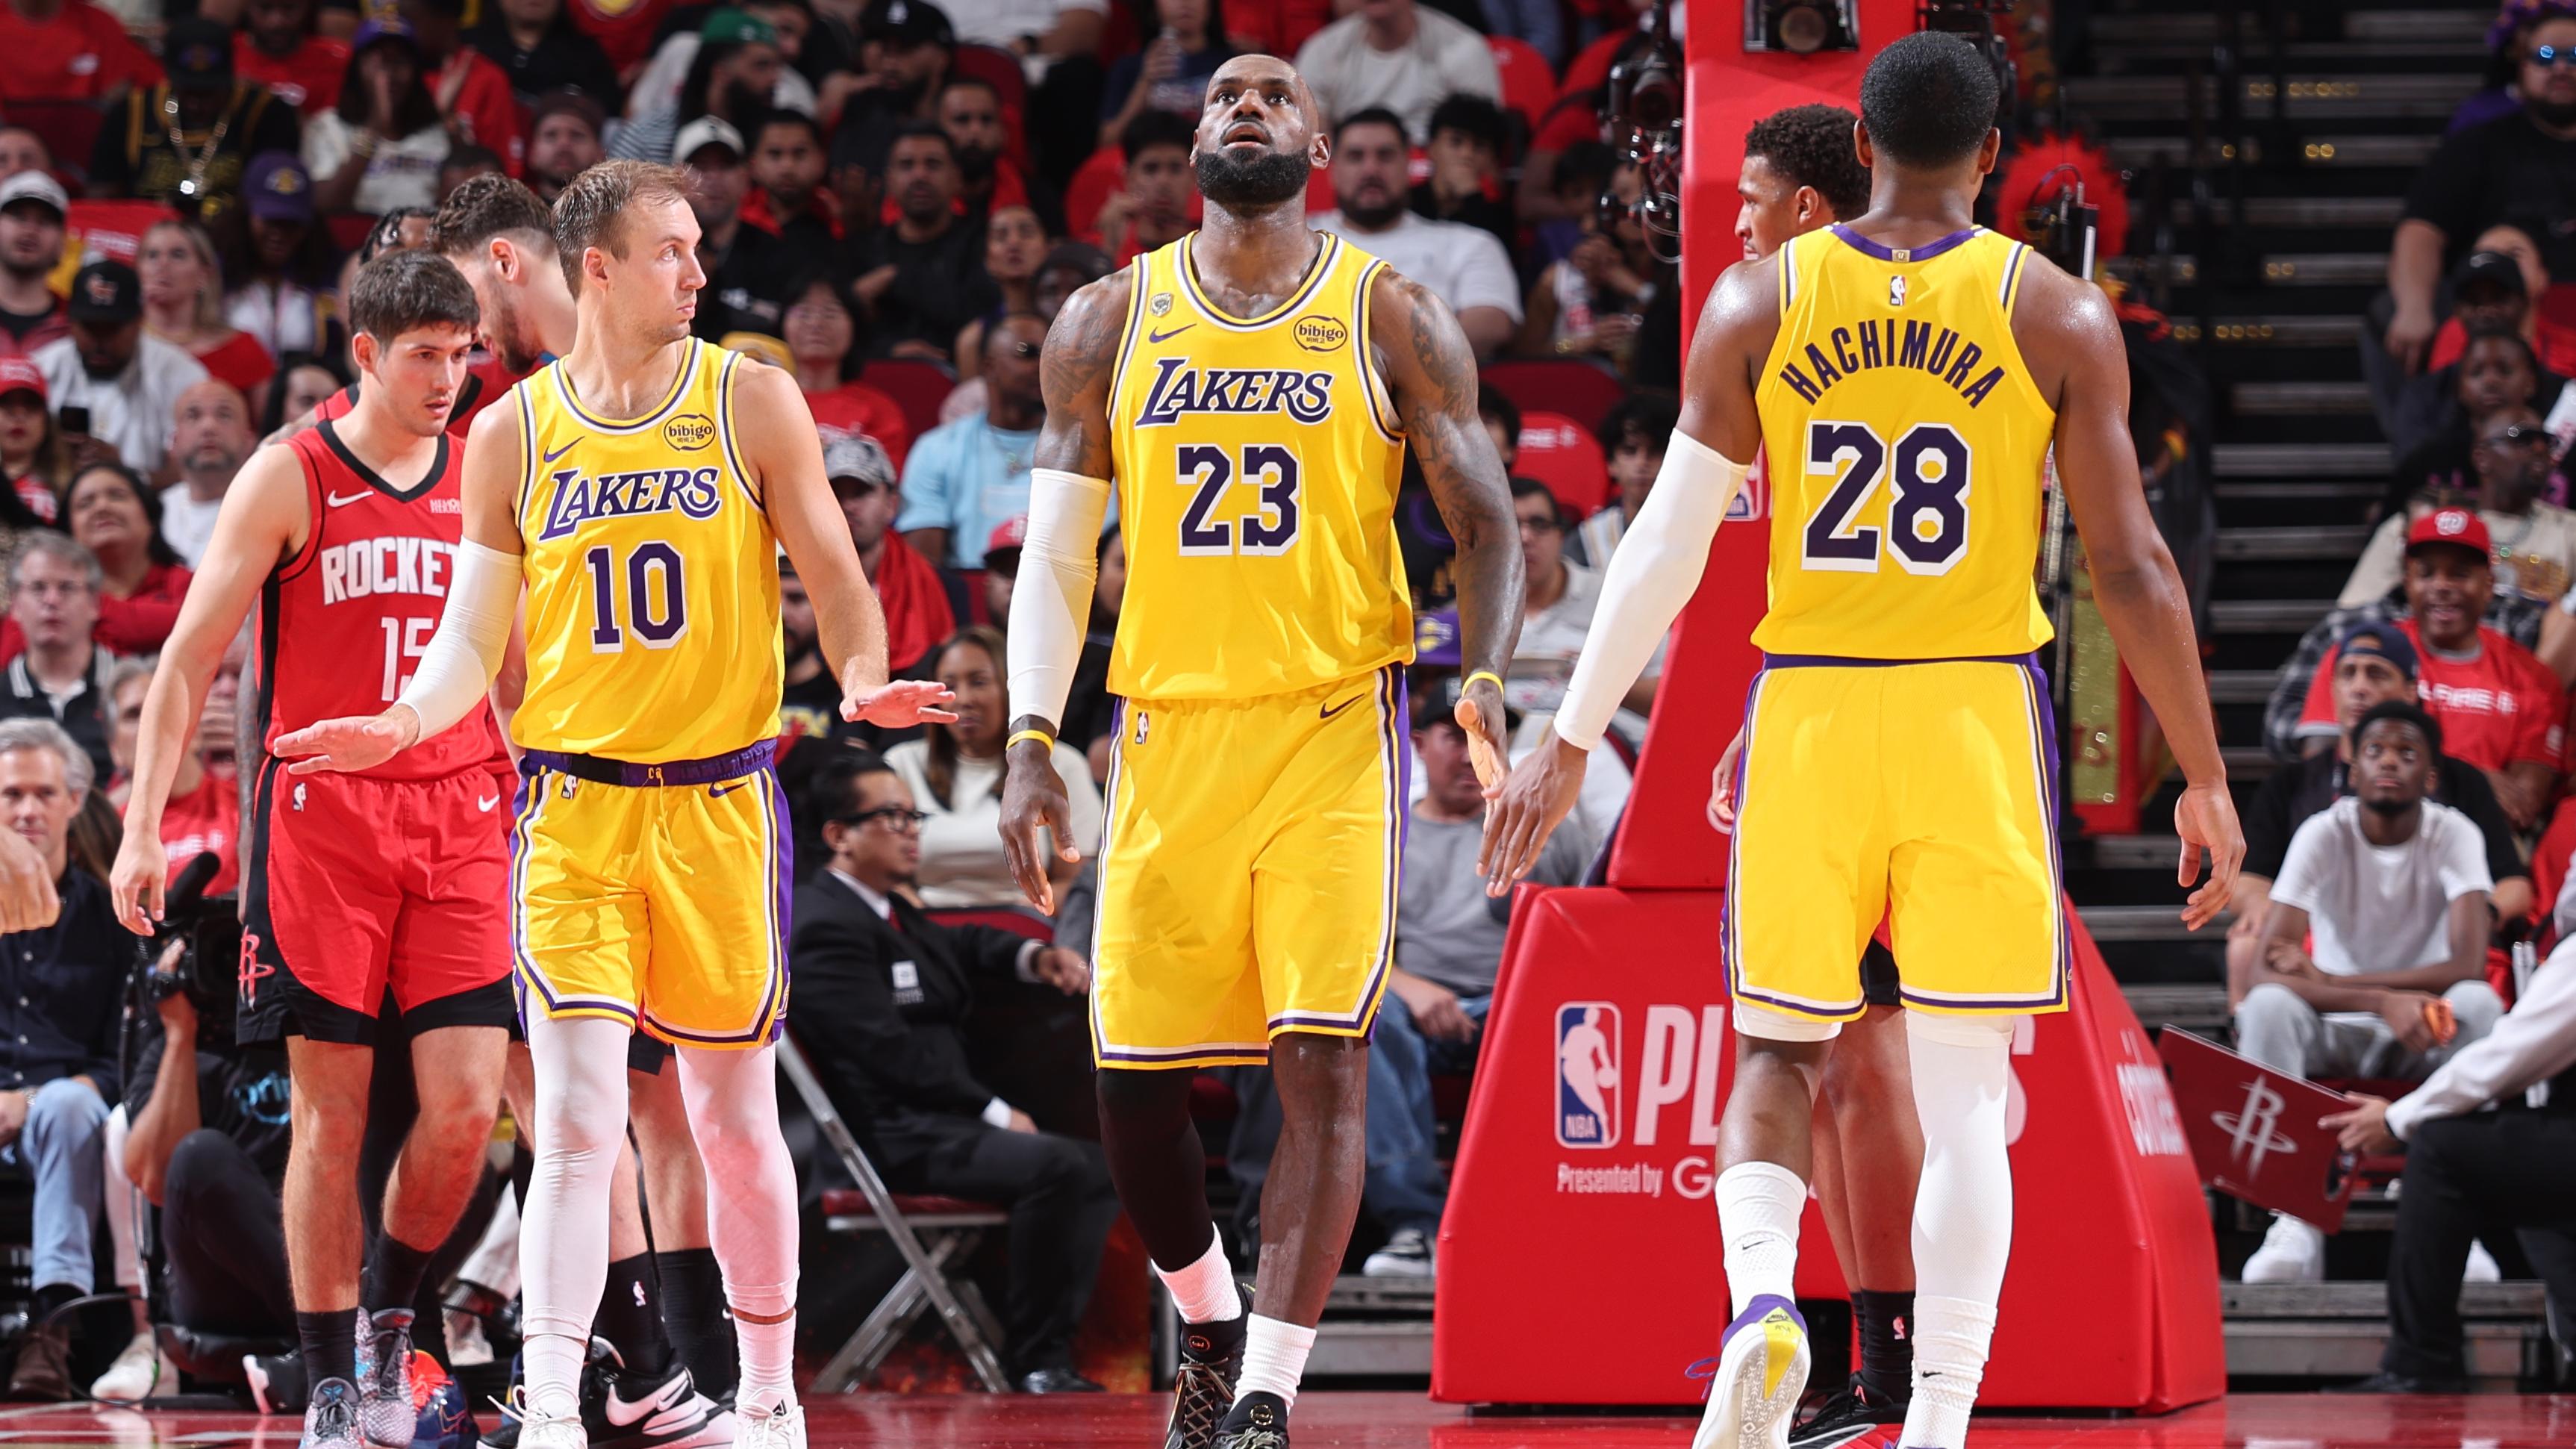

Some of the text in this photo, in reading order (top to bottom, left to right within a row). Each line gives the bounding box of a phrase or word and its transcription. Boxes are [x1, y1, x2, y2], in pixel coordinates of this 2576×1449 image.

[1299, 324, 1344, 342] bibigo
[1780, 318, 2006, 409] HACHIMURA
[1135, 357, 1335, 429] LAKERS
[668, 423, 713, 440] bibigo
[537, 466, 723, 543] LAKERS
[1175, 443, 1300, 556] 23
[1801, 420, 1971, 576] 28
[585, 540, 688, 654] 10
[1565, 1114, 1597, 1138] NBA
[1556, 1162, 1640, 1194] Presented
[1642, 1162, 1664, 1197] by
